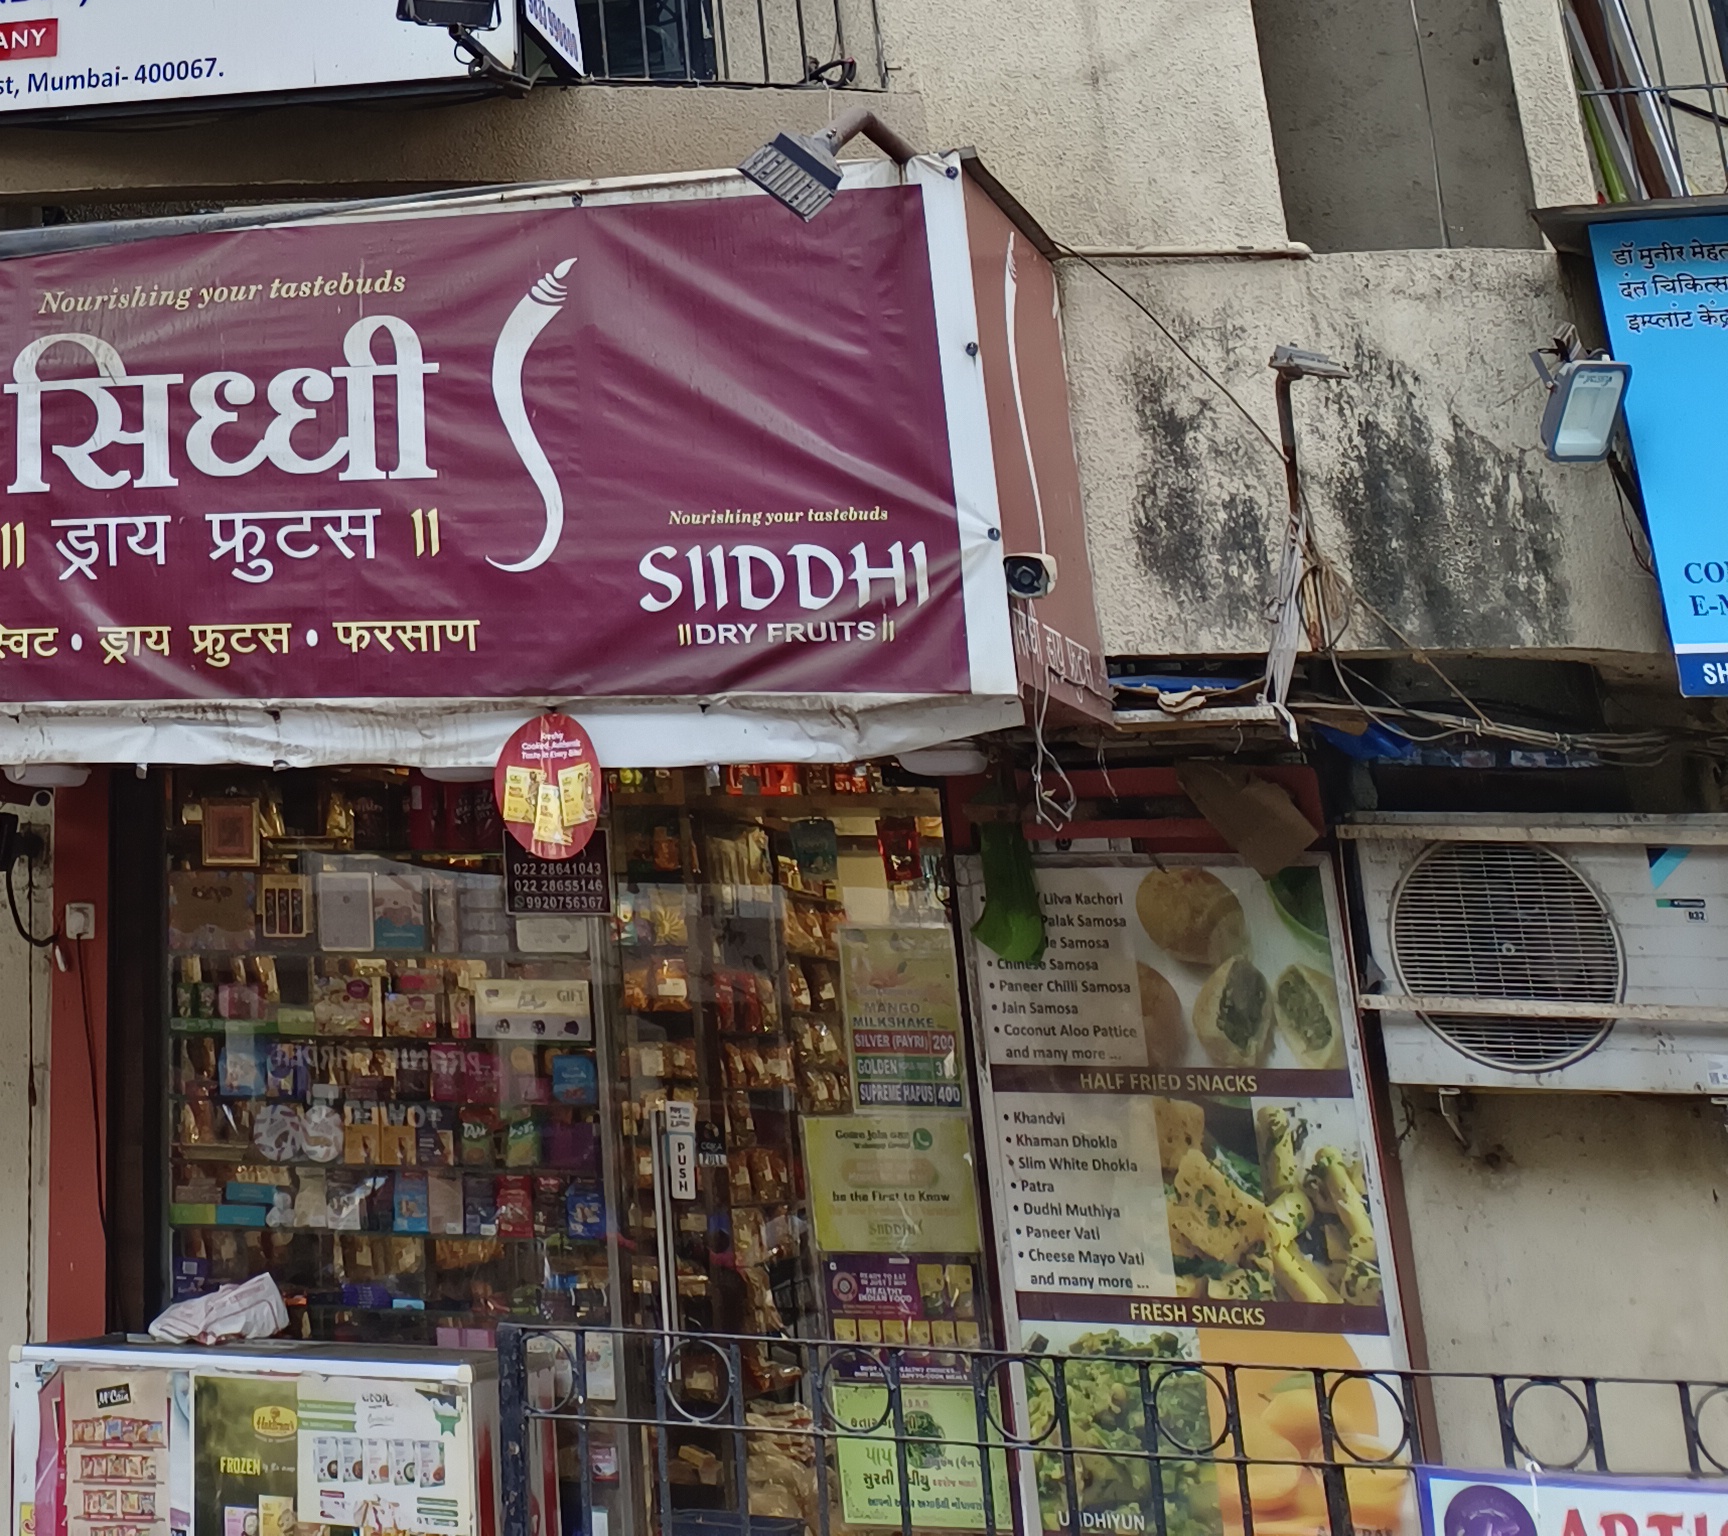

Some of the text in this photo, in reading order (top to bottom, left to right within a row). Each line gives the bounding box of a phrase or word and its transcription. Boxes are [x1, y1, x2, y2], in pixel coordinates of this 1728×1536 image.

[134, 56, 226, 85] 400067.
[1637, 241, 1687, 269] मुनीर
[38, 269, 407, 316] Nourishing your tastebuds
[1618, 272, 1648, 300] दंत
[668, 505, 889, 527] Nourishing your tastebuds
[50, 508, 382, 585] ड्राय फ्रुटस
[638, 539, 932, 613] SIIDDHI
[97, 625, 172, 666] ड्राय
[332, 619, 481, 656] फरसाण
[514, 862, 602, 876] 022 28641043
[526, 896, 604, 910] 9920756367
[1075, 892, 1124, 906] Kachori
[1041, 914, 1127, 929] Palak Samosa
[1060, 937, 1110, 950] Samosa
[999, 980, 1078, 994] Paneer Chilli
[864, 1002, 921, 1015] MANGO
[1001, 1001, 1026, 1016] Jain
[852, 1016, 935, 1029] MILKSHAKE
[1004, 1024, 1138, 1040] Coconut Aloo Pattice
[854, 1034, 955, 1050] SILVER 200
[857, 1059, 898, 1075] GOLDEN
[1079, 1072, 1258, 1093] HALF FRIED SNACKS
[859, 1083, 961, 1103] SUPREME 400
[1013, 1111, 1066, 1125] Khandvi
[1015, 1133, 1118, 1150] Khaman Dhokla
[677, 1141, 689, 1193] PUSH
[1018, 1157, 1138, 1173] Slim White Dhokla
[1020, 1179, 1055, 1194] Patra
[1023, 1202, 1121, 1220] Dudhi Muthiya
[1026, 1225, 1101, 1241] Paneer Vati
[1028, 1248, 1116, 1267] Cheese Mayo
[1030, 1271, 1134, 1290] and many more
[1129, 1302, 1267, 1326] FRESH SNACKS
[219, 1455, 263, 1477] FROZEN
[1058, 1510, 1146, 1532] UDHIYUN
